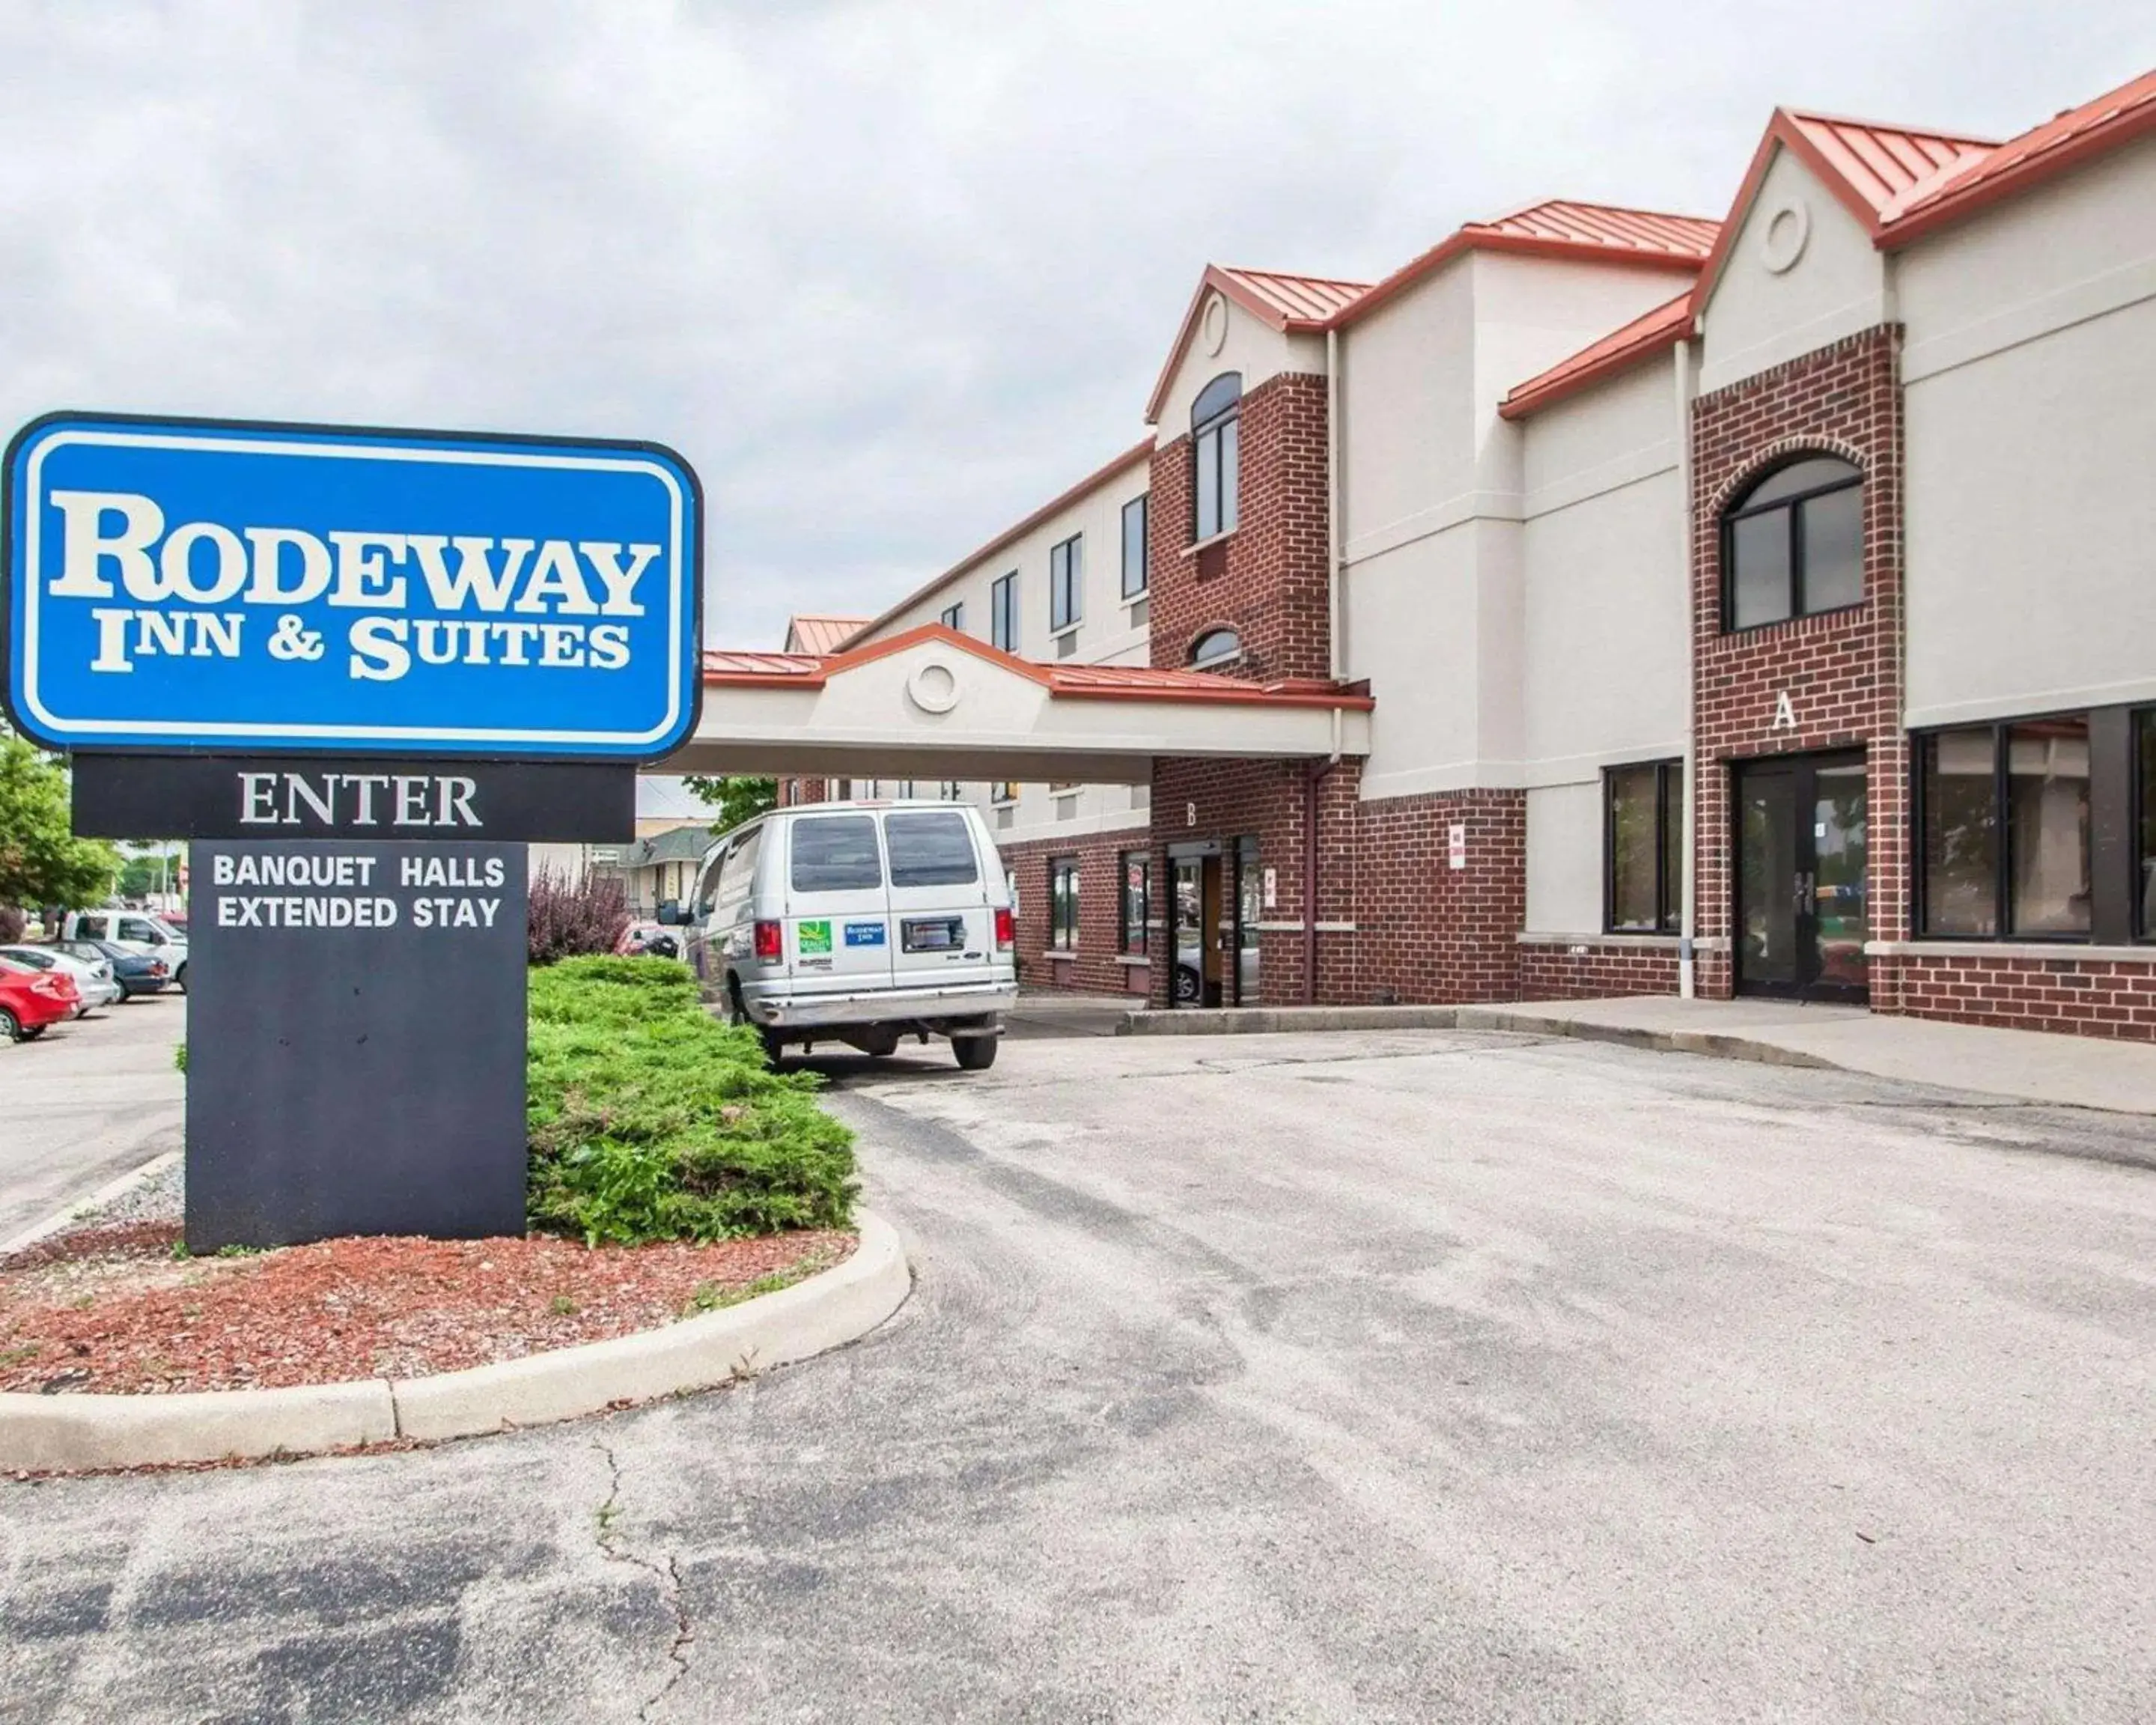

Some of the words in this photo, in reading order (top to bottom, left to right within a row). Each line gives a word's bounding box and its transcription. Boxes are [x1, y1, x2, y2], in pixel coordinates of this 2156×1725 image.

[49, 490, 661, 616] RODEWAY
[91, 608, 245, 672] INN
[268, 614, 324, 660] &
[349, 616, 630, 681] SUITES
[1772, 691, 1797, 731] A
[237, 772, 484, 827] ENTER
[1187, 803, 1196, 826] B
[213, 854, 376, 887] BANQUET
[401, 857, 505, 888] HALLS
[217, 896, 398, 928] EXTENDED
[412, 897, 501, 928] STAY
